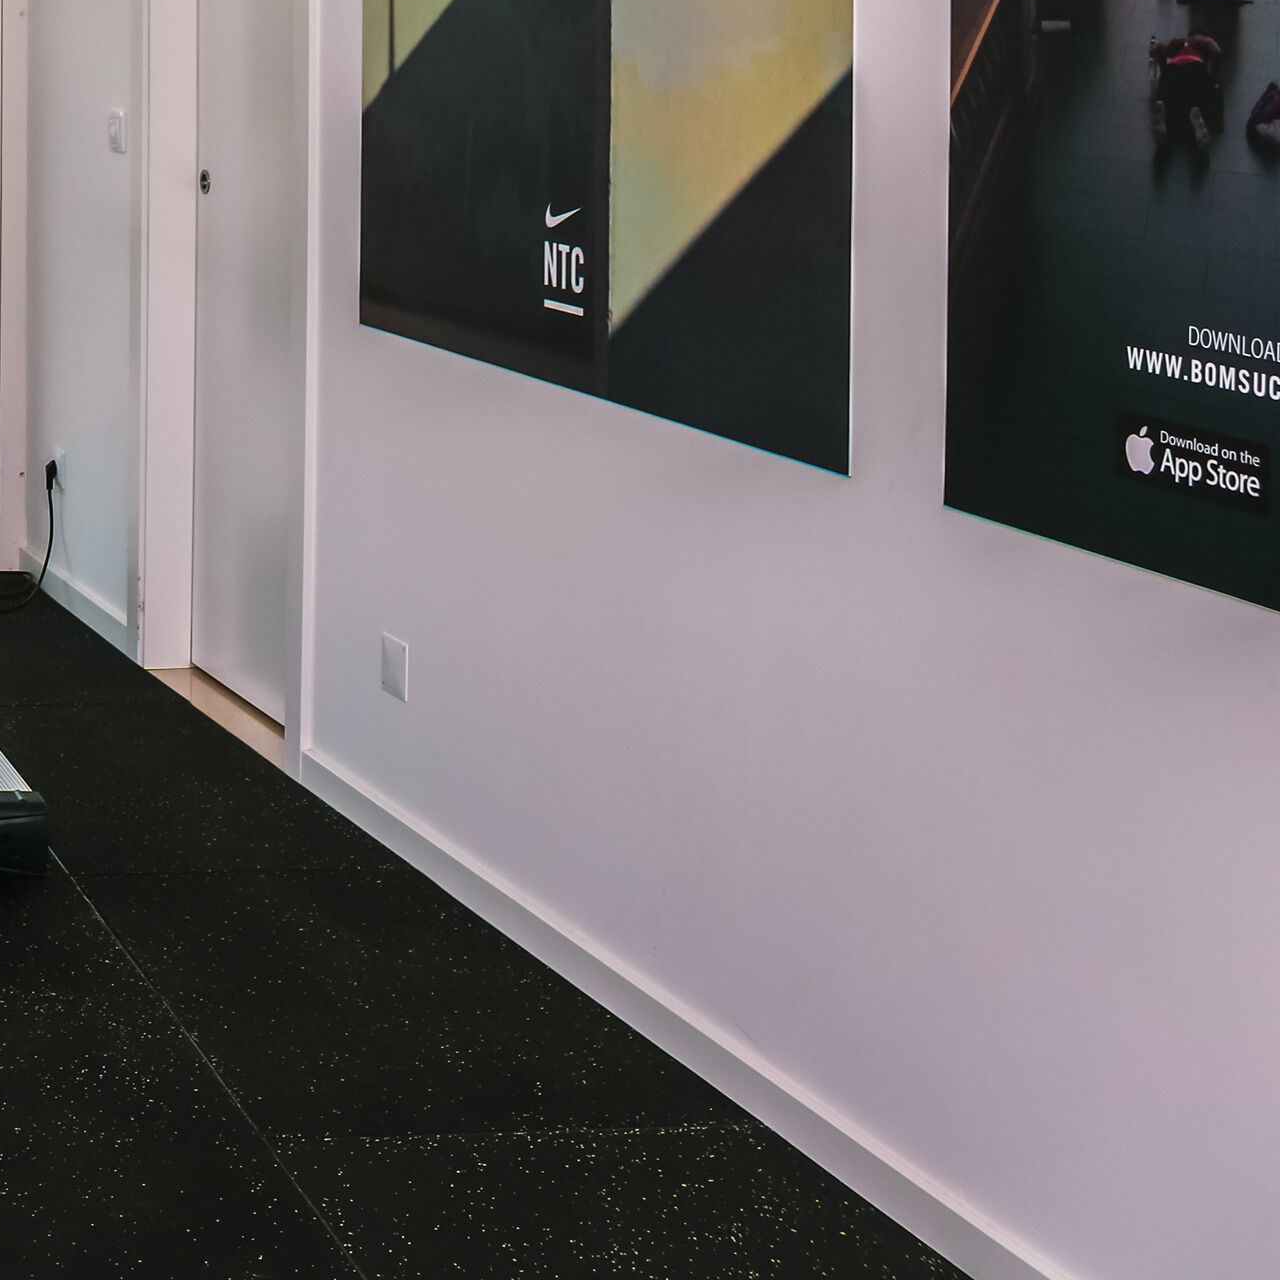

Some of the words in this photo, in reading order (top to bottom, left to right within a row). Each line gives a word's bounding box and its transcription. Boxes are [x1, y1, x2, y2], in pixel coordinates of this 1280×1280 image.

[543, 240, 585, 294] NTC
[1126, 345, 1280, 401] WWW.BOMSUC
[1160, 430, 1219, 456] Download
[1221, 448, 1237, 461] on
[1239, 450, 1261, 467] the
[1160, 448, 1202, 486] App
[1205, 459, 1261, 497] Store
